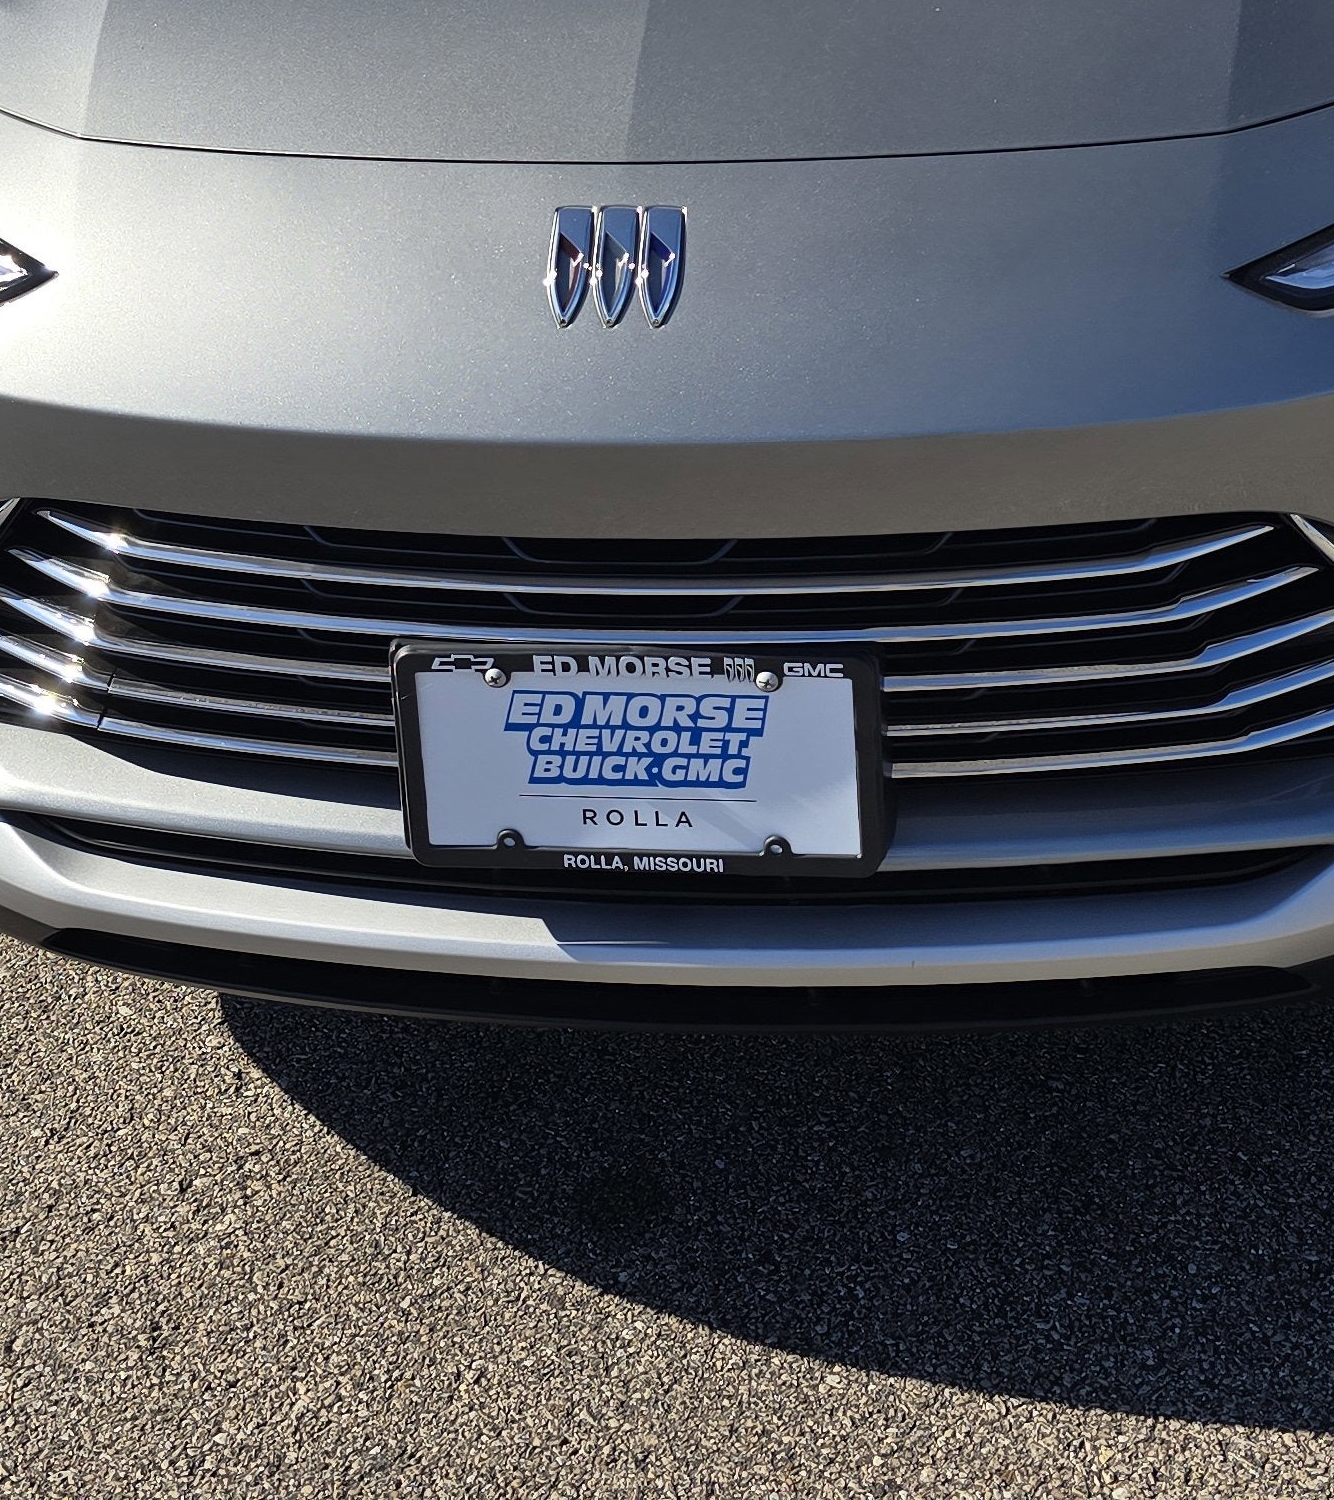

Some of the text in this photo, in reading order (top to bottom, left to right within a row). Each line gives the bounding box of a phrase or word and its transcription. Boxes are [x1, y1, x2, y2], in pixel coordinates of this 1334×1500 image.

[532, 655, 713, 680] ED MORSE
[784, 662, 844, 677] GMC
[508, 693, 766, 729] ED MORSE
[529, 727, 748, 755] CHEVROLET
[582, 808, 693, 828] ROLLA
[563, 853, 724, 873] ROLLA, MISSOURI
